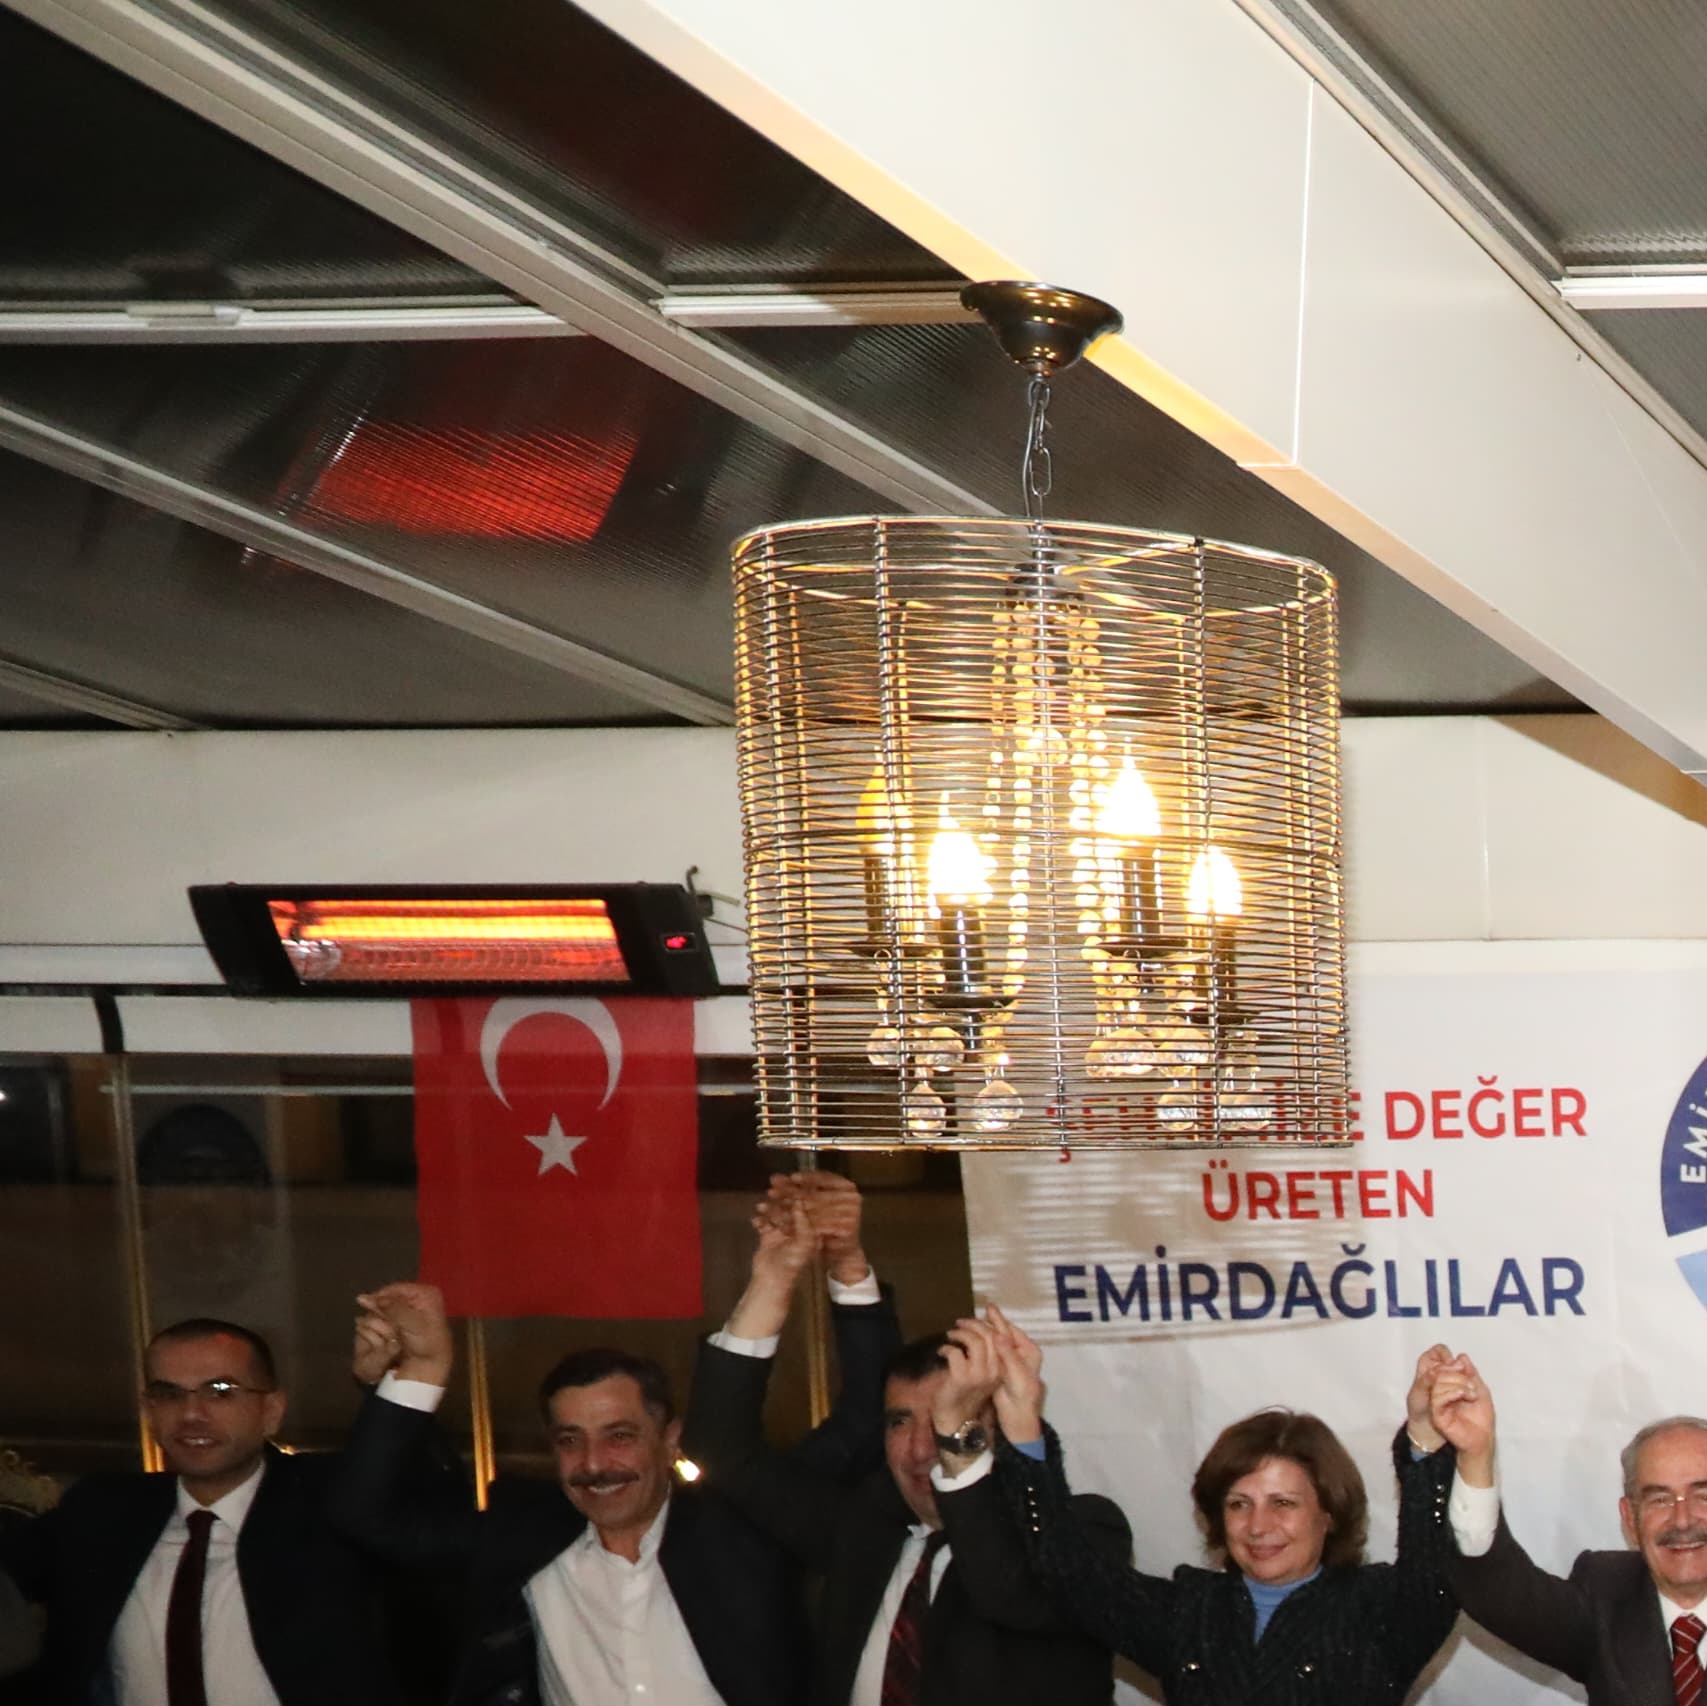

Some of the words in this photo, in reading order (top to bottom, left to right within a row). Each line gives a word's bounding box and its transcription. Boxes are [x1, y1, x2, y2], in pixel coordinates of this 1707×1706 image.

[1385, 1075, 1587, 1140] DEĞER
[1202, 1160, 1434, 1221] ÜRETEN
[1053, 1243, 1587, 1323] EMİRDAĞLILAR
